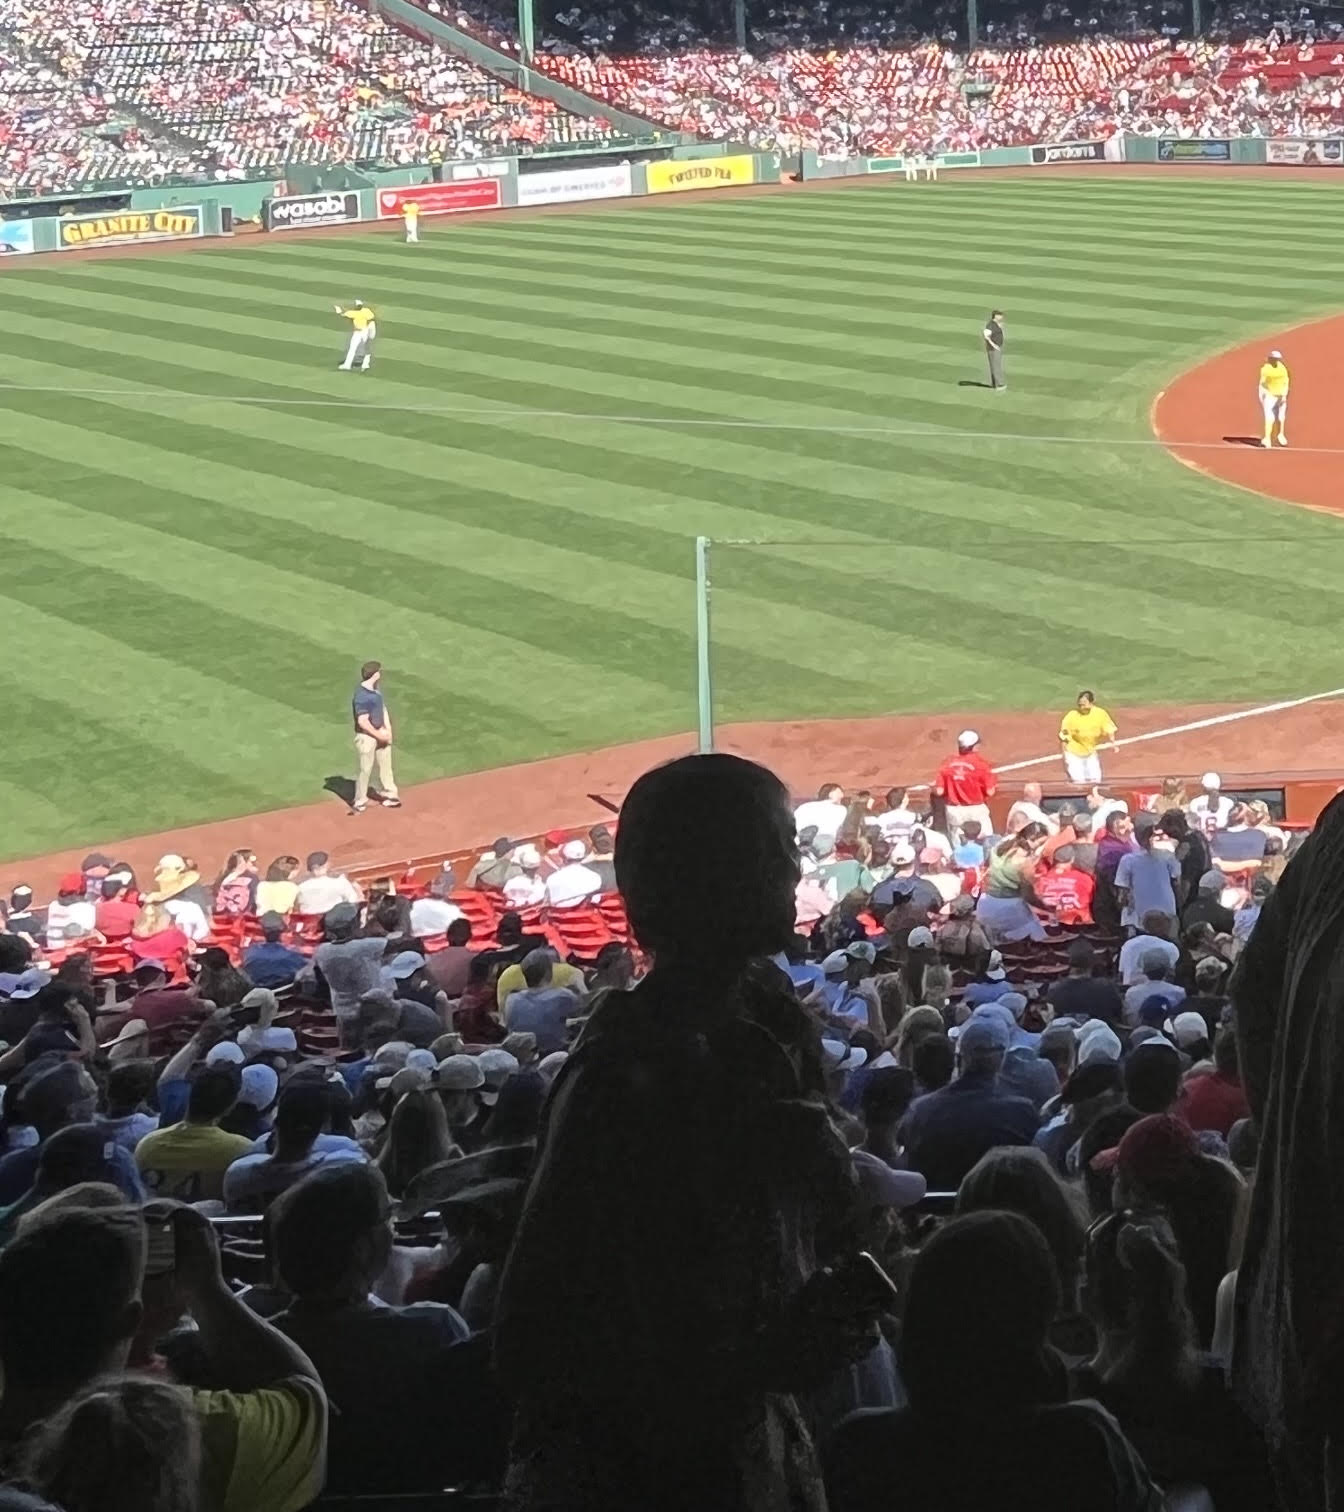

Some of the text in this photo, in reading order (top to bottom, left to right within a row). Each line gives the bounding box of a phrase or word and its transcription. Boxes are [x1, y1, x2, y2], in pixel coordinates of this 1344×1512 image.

[273, 195, 346, 218] wasabi
[63, 212, 198, 243] GRANITE CITY
